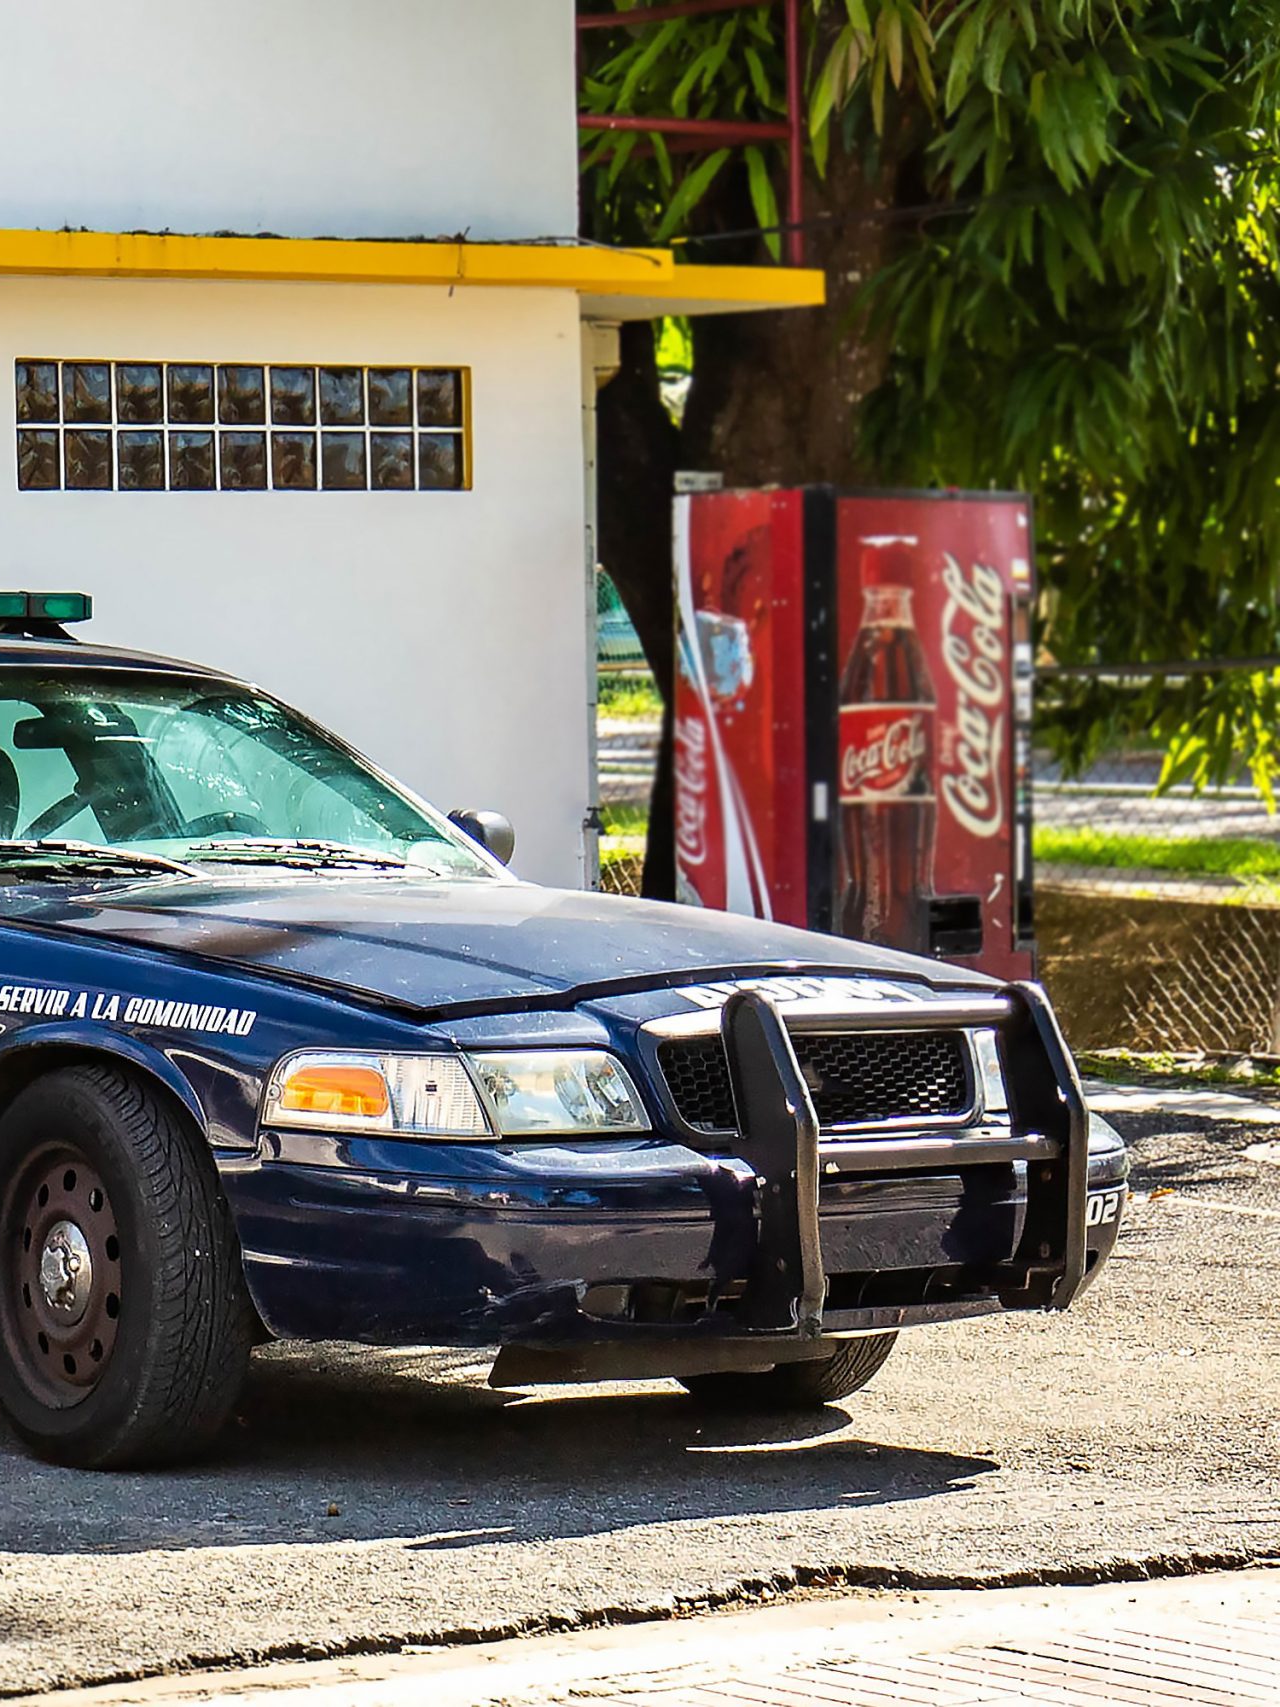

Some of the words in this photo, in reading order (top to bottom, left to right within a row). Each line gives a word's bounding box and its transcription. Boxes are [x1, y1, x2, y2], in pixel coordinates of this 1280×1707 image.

[941, 550, 1004, 837] Coca-Cola
[70, 992, 88, 1018] A
[91, 993, 121, 1021] LA
[123, 997, 257, 1036] COMUNIDAD
[1086, 1192, 1119, 1227] 02
